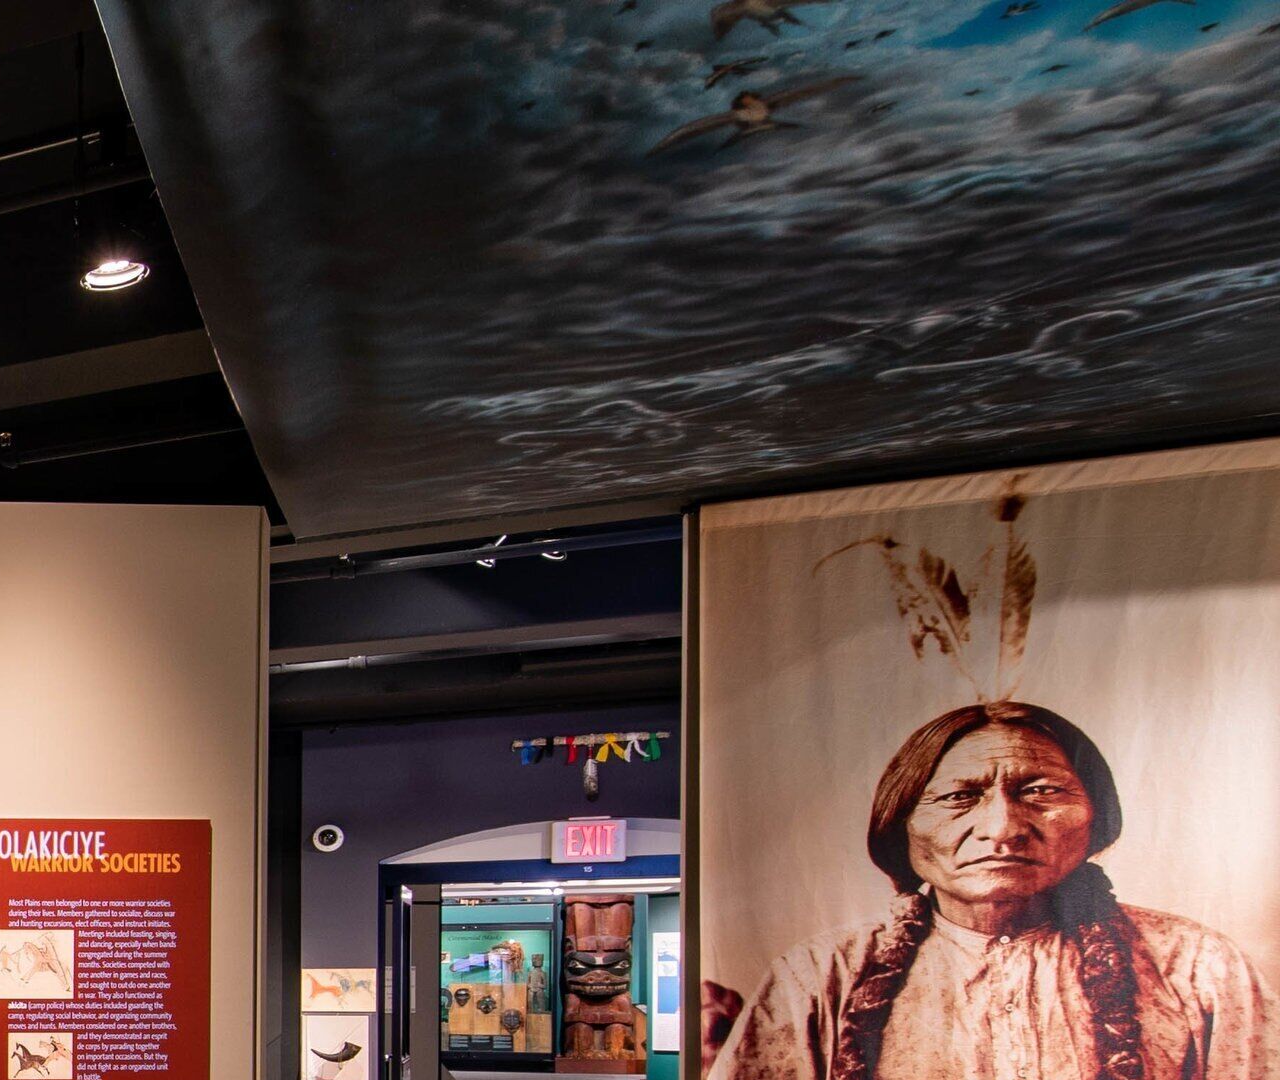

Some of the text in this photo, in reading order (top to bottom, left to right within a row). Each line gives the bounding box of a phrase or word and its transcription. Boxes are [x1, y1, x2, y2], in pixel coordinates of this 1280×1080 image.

[566, 825, 616, 858] EXIT
[11, 853, 181, 873] WARRIOR SOCIETIES
[8, 899, 24, 907] Most
[24, 899, 41, 907] Plains
[55, 899, 82, 909] belonged
[125, 899, 146, 907] warrior
[146, 899, 171, 907] societies
[8, 909, 27, 919] during
[28, 909, 41, 917] their
[57, 909, 84, 917] Members
[84, 909, 110, 919] gathered
[143, 909, 163, 917] discuss
[20, 919, 43, 929] hunting
[75, 919, 89, 927] elect
[125, 919, 147, 927] instruct
[78, 929, 105, 939] Meetings
[105, 929, 130, 938] included
[114, 940, 141, 950] especially
[142, 940, 158, 948] when
[159, 940, 176, 948] bands
[78, 950, 113, 960] congregated
[114, 950, 132, 960] during
[101, 960, 127, 968] Societies
[127, 960, 156, 970] competed
[157, 960, 170, 968] with
[90, 970, 112, 978] another
[119, 972, 139, 980] games
[97, 991, 112, 1001] They
[112, 991, 124, 999] also
[124, 991, 156, 999] functioned
[25, 1011, 54, 1021] regulating
[55, 1011, 71, 1019] social
[110, 1011, 139, 1021] organizing
[140, 1011, 172, 1021] community
[58, 1021, 85, 1029] Members
[86, 1021, 116, 1029] considered
[128, 1021, 151, 1029] another
[88, 1031, 102, 1041] they
[102, 1031, 142, 1040] demonstrated
[151, 1031, 168, 1041] esprit
